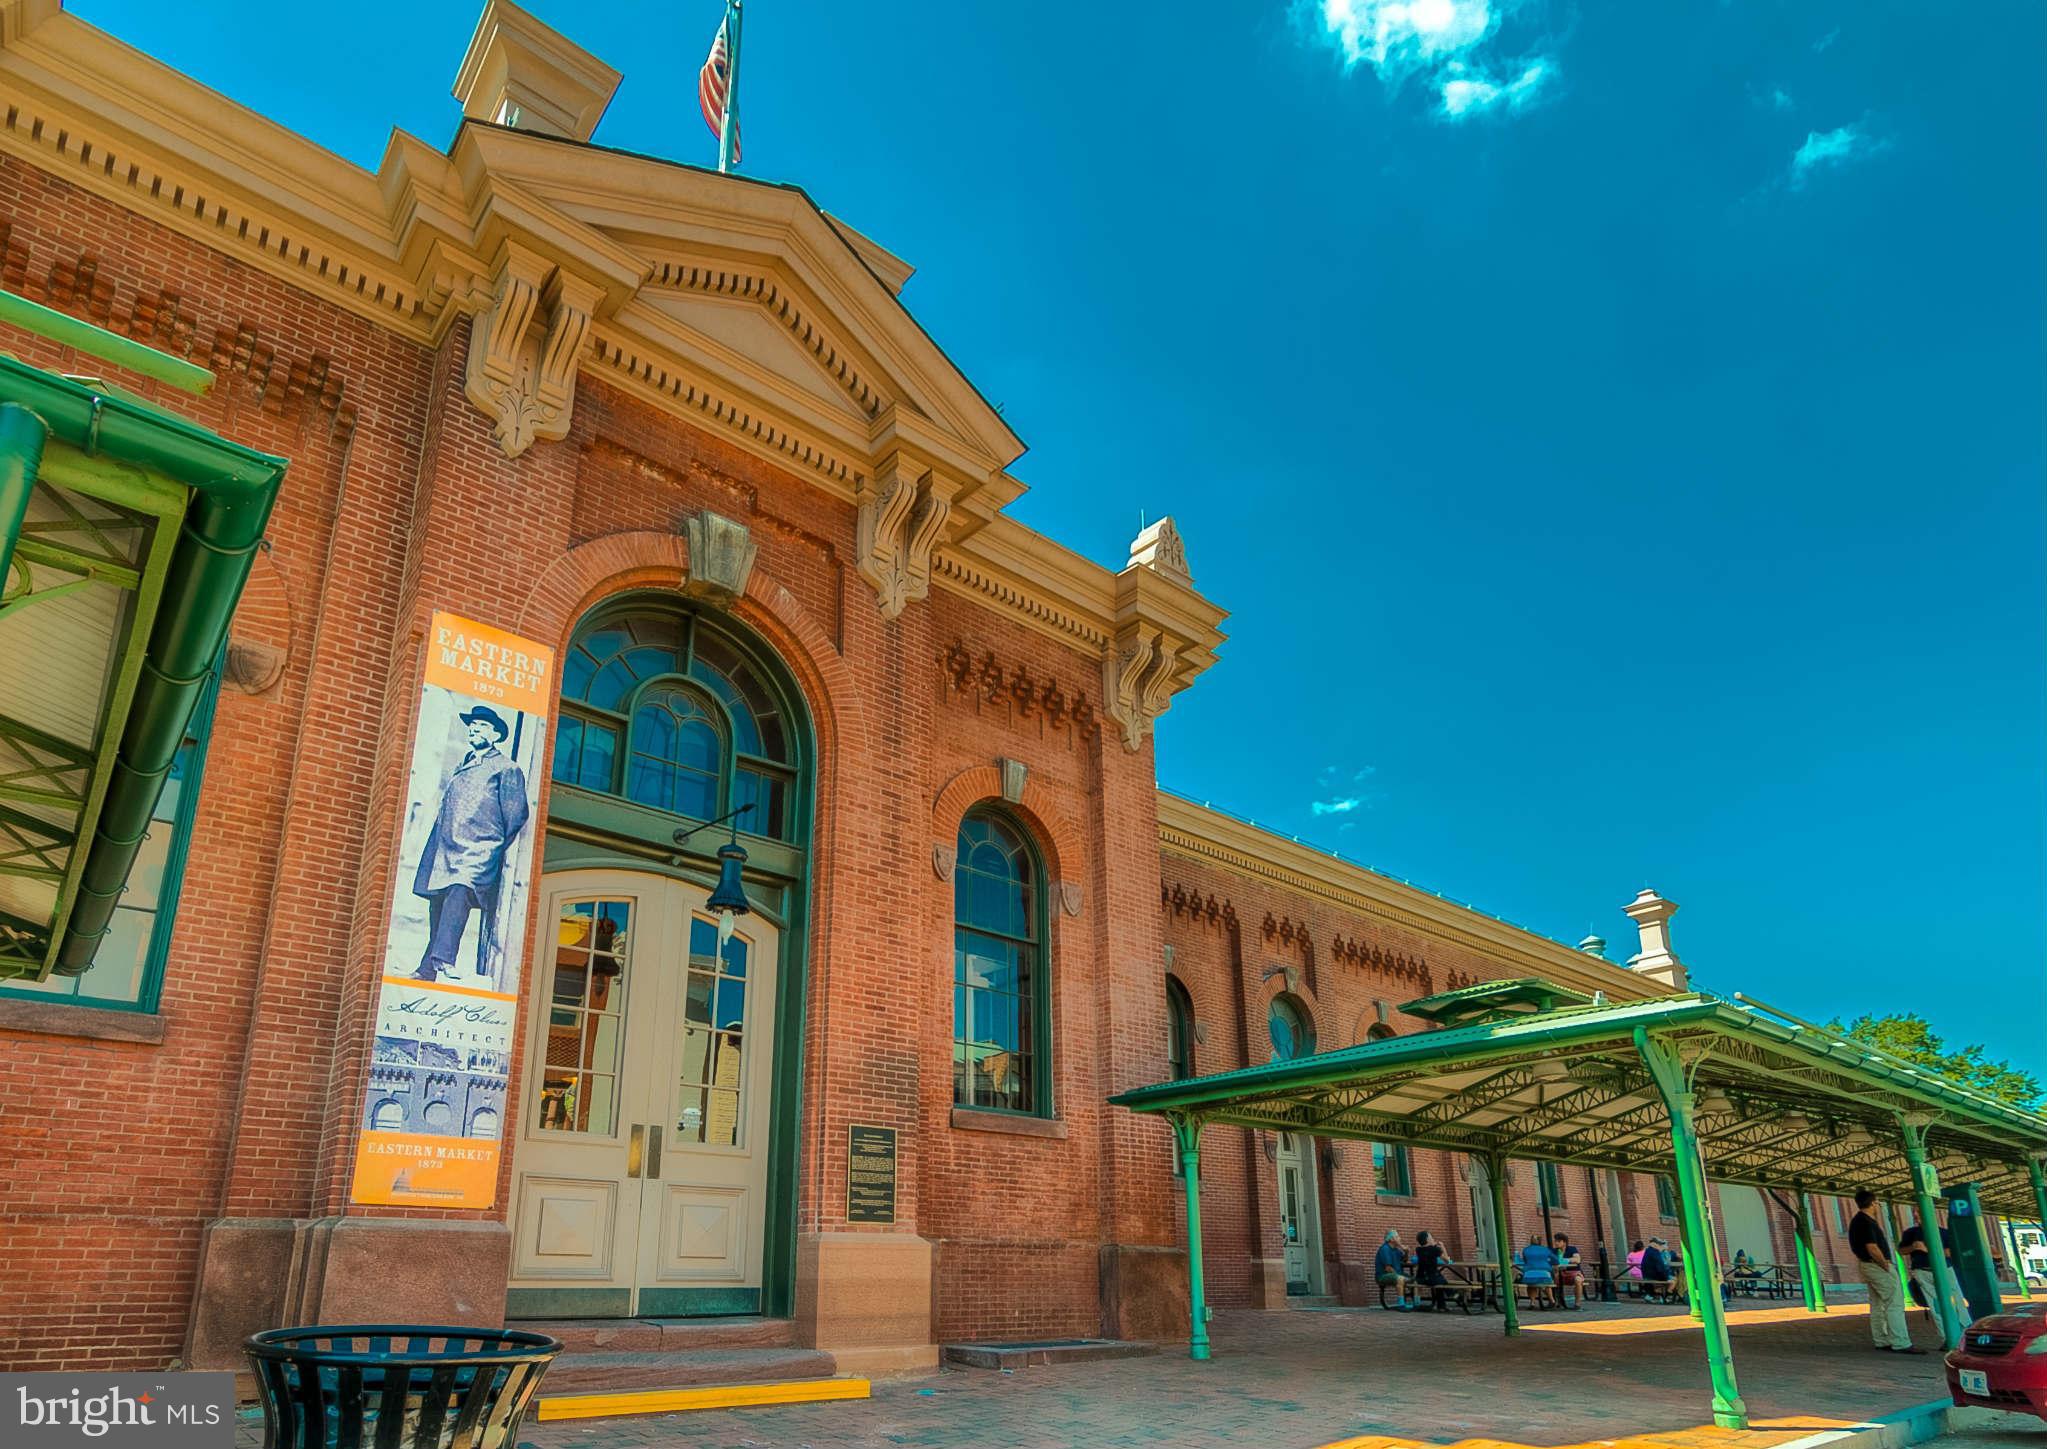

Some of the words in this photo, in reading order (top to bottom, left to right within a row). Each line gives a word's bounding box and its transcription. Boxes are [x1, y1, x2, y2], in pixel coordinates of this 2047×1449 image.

[436, 626, 546, 677] EASTERN
[439, 646, 541, 693] MARKET
[473, 681, 504, 698] 1873
[387, 997, 464, 1025] Adolf
[384, 1023, 505, 1046] ARCHITECT
[367, 1142, 433, 1157] EASTERN
[436, 1147, 493, 1161] MARKET
[1954, 1200, 1968, 1216] P
